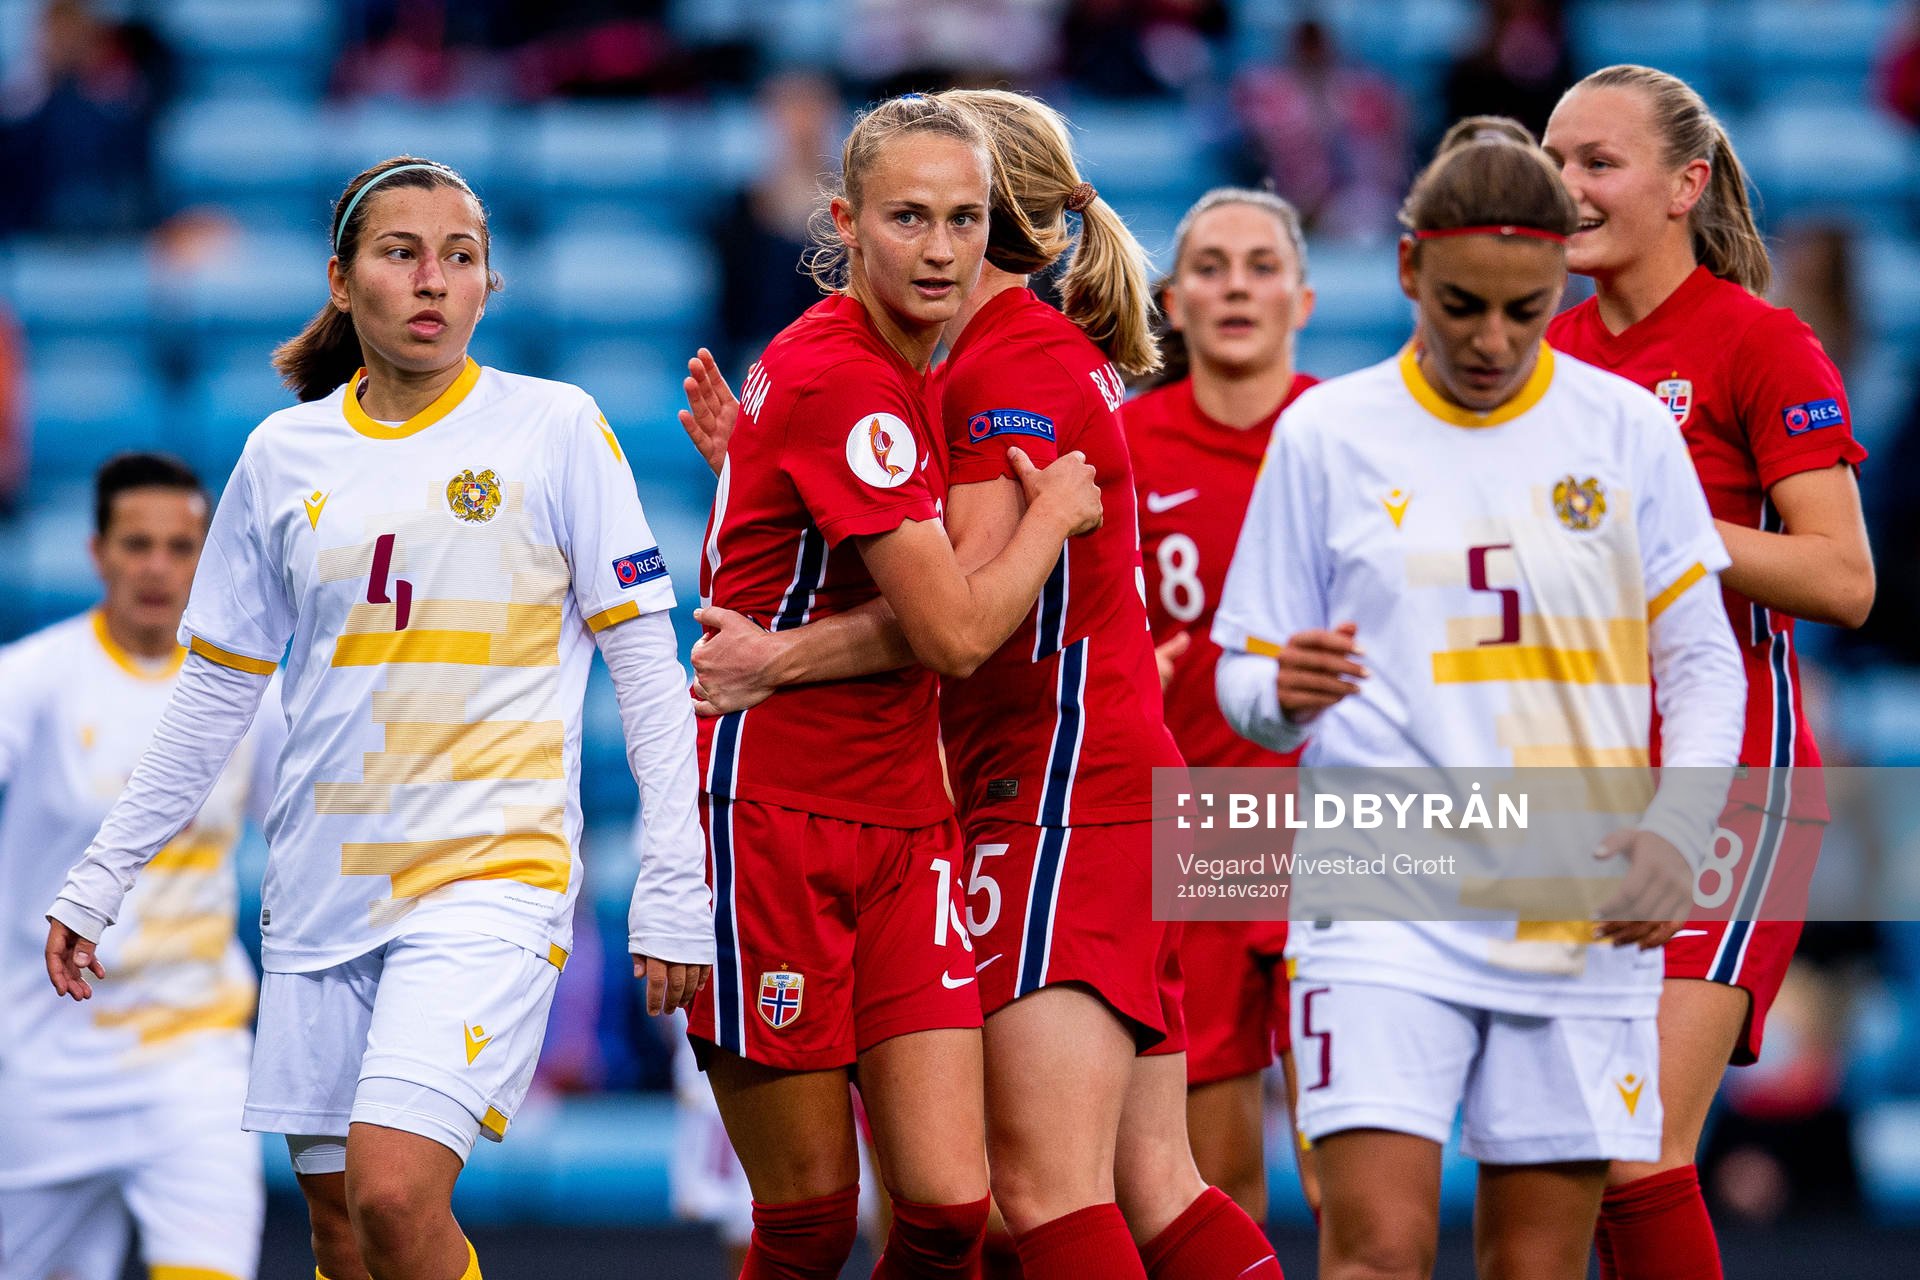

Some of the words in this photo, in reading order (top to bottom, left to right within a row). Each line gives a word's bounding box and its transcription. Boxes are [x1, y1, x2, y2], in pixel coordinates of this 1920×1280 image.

[993, 416, 1054, 436] RESPECT
[366, 533, 413, 631] 4
[1156, 533, 1206, 623] 8
[1468, 544, 1521, 646] 5
[965, 843, 1010, 937] 5
[1303, 988, 1331, 1092] 5
